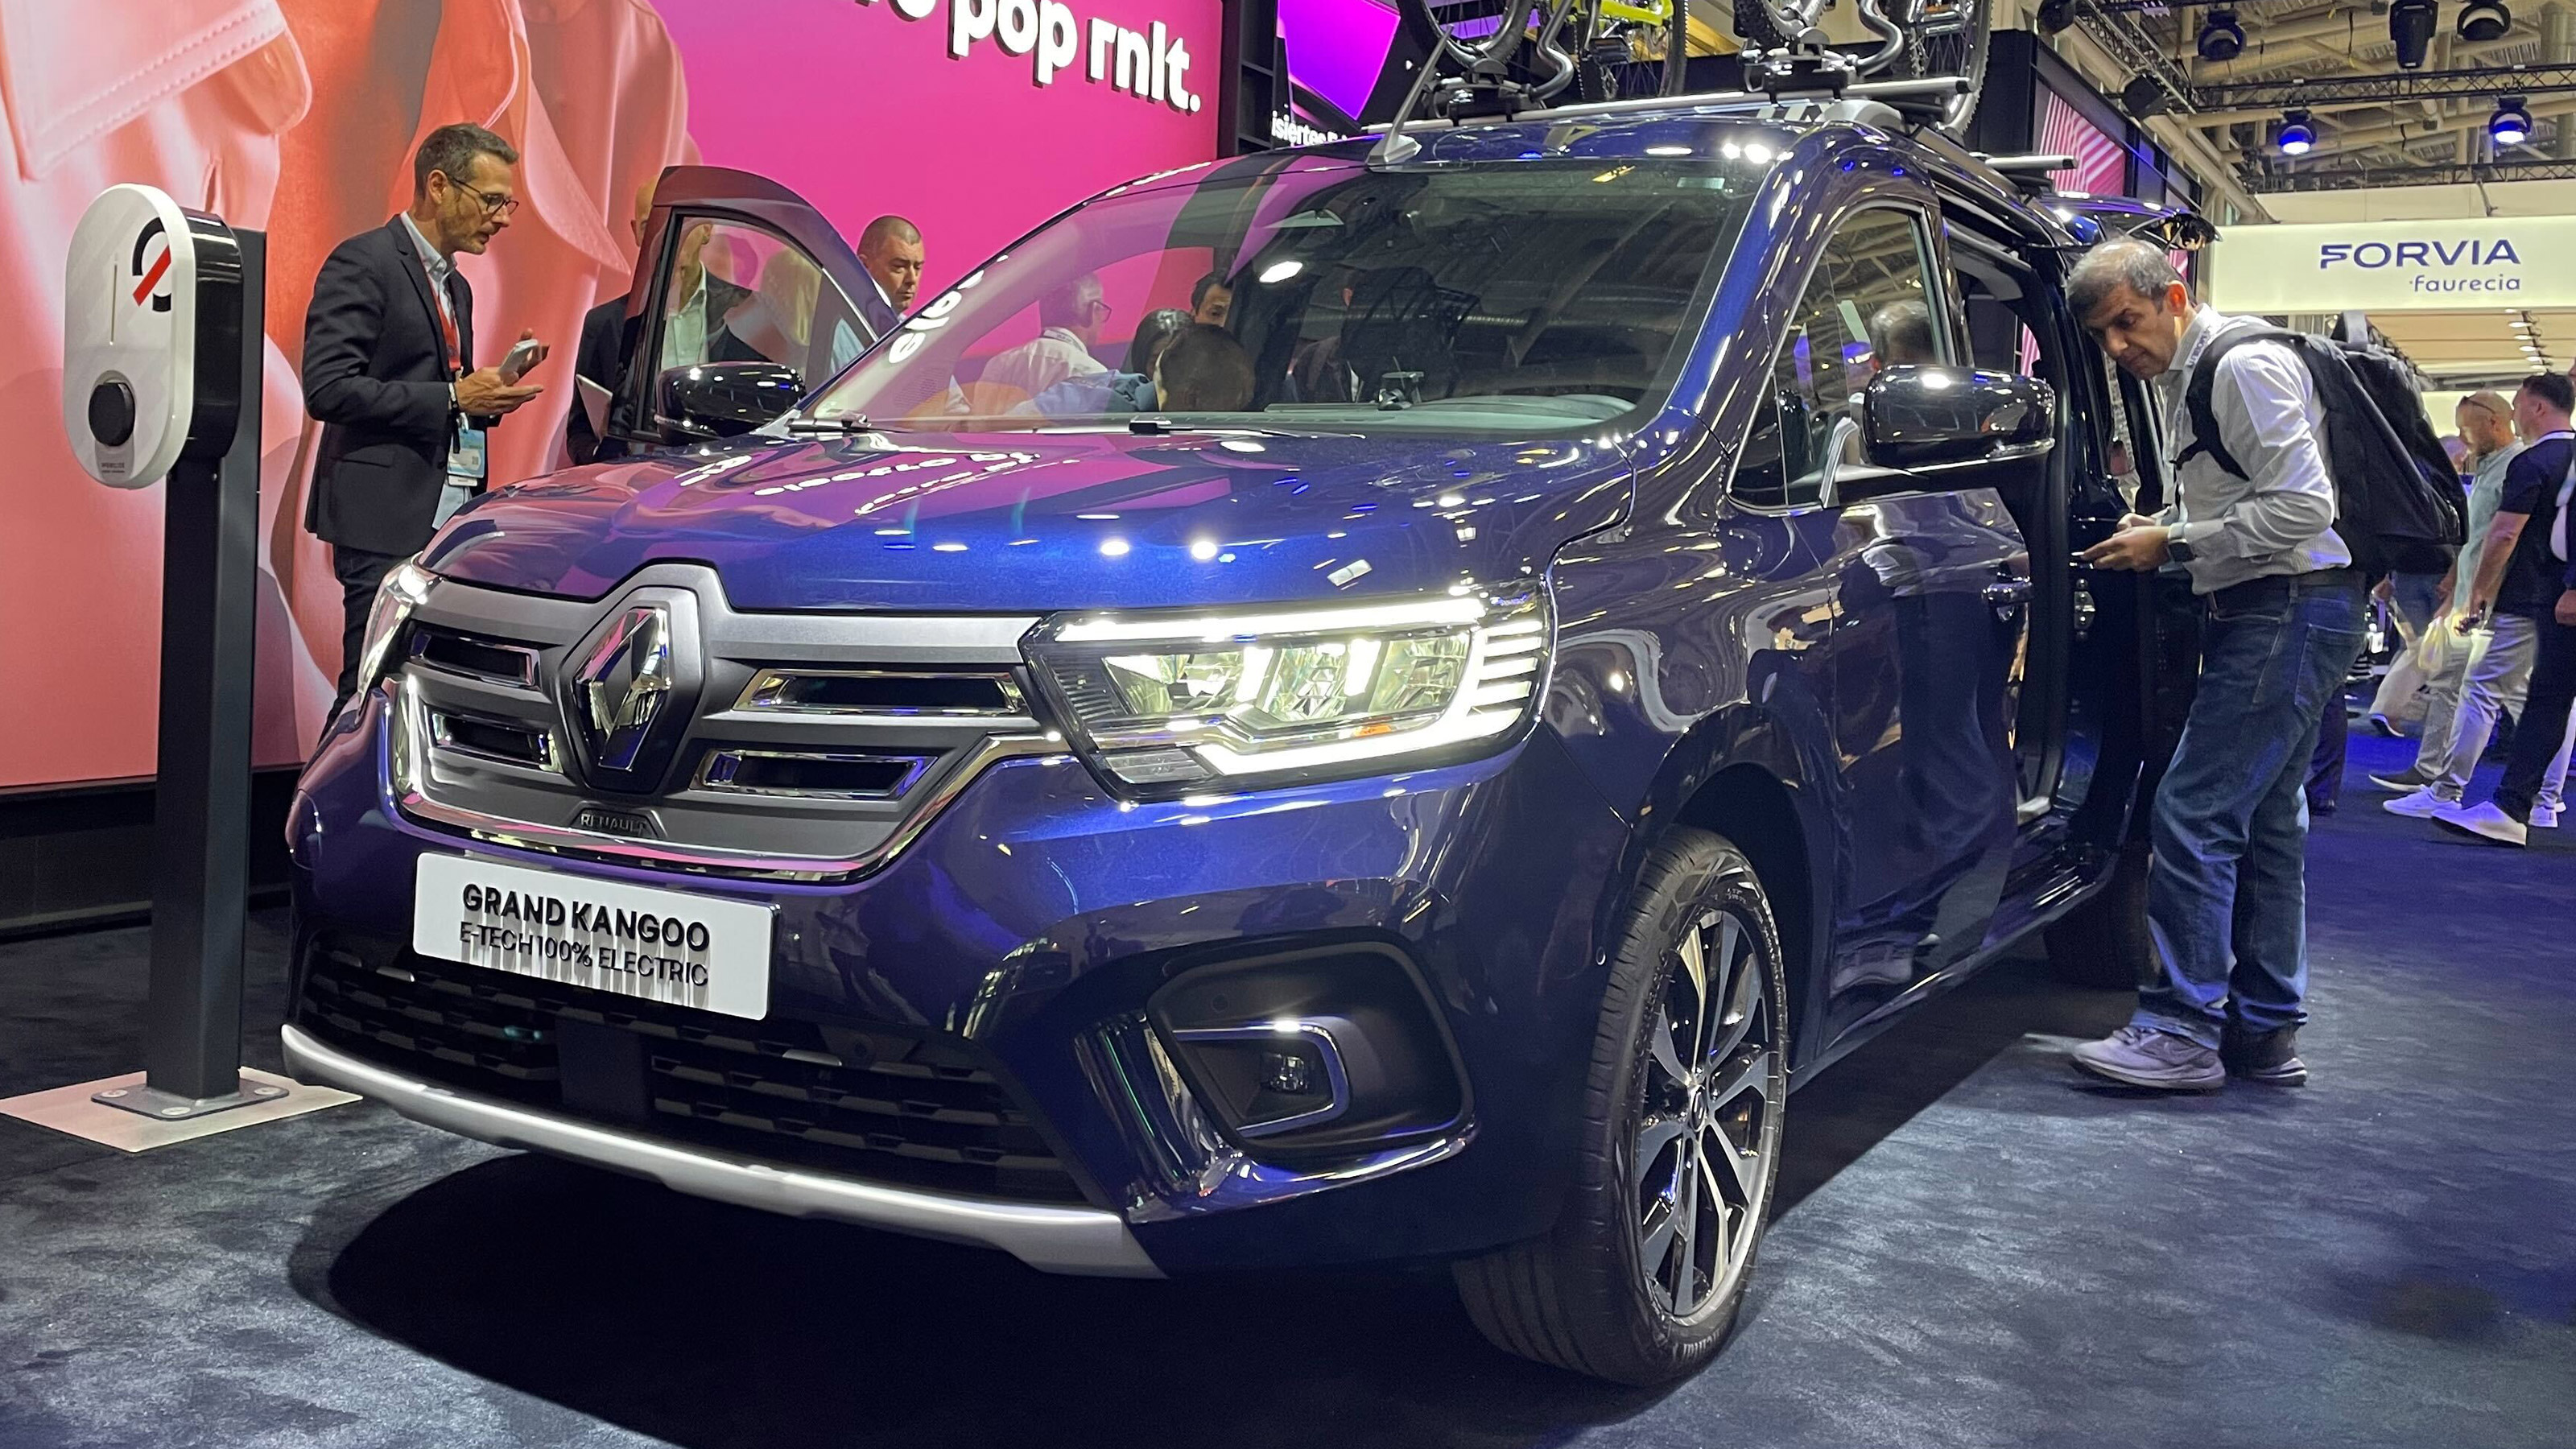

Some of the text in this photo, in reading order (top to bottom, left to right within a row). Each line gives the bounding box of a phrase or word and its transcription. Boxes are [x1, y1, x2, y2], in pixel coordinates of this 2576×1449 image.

[952, 0, 1201, 112] pop rnlt.
[2320, 239, 2521, 270] FORVIA
[2413, 274, 2520, 292] faurecia
[580, 813, 646, 836] RENAULT
[463, 883, 709, 952] GRAND KANGOO
[460, 922, 708, 987] E-TECH 100% ELECTRIC
